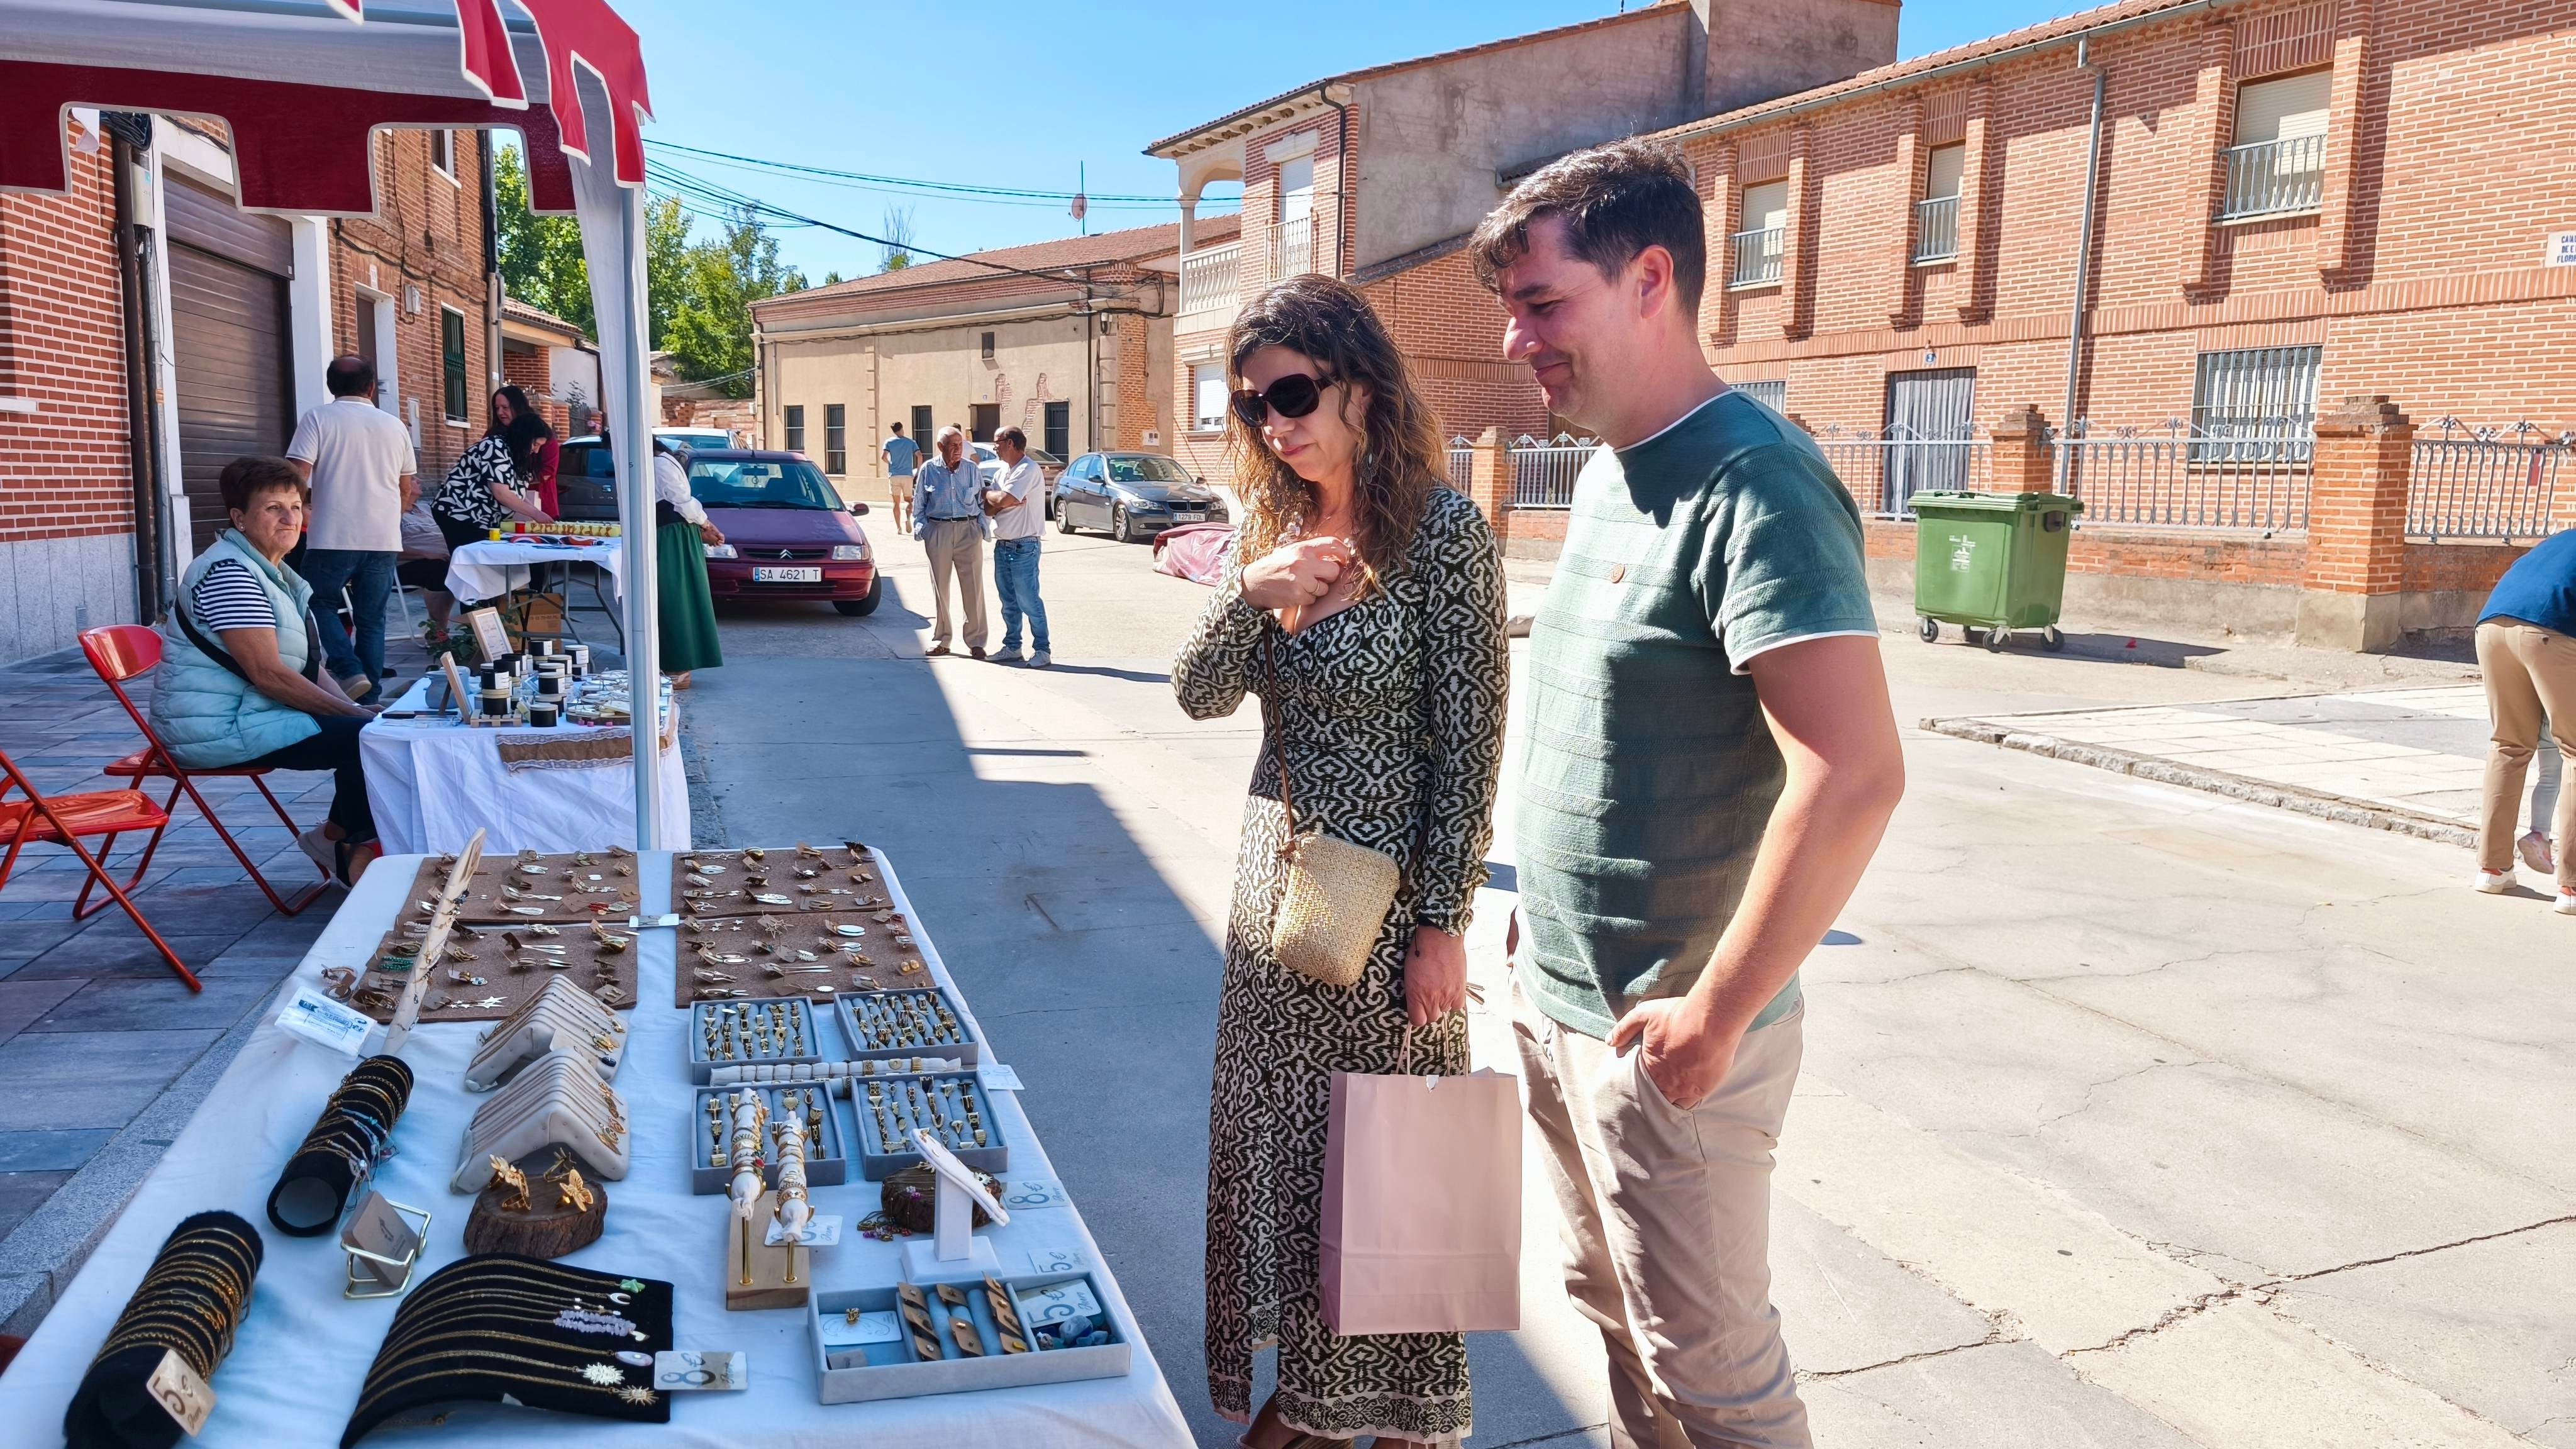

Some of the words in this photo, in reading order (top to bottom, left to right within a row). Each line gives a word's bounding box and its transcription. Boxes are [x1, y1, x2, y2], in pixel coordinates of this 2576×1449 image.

[760, 569, 774, 580] SA
[780, 569, 805, 580] 4621
[813, 569, 819, 580] T
